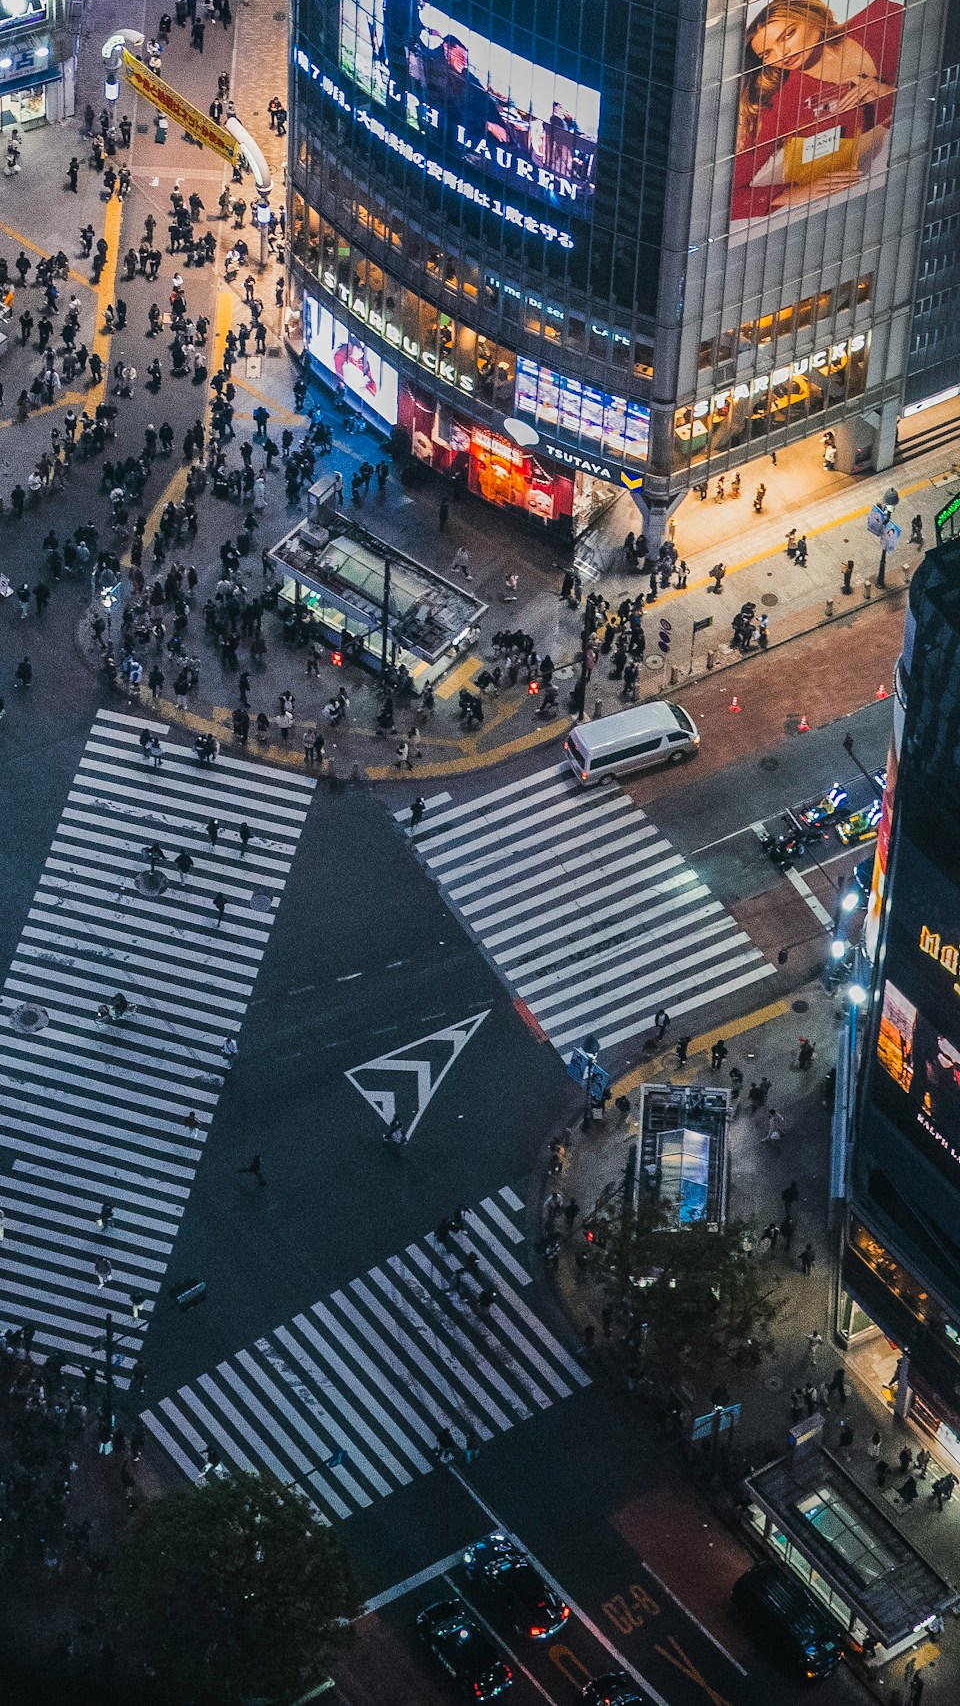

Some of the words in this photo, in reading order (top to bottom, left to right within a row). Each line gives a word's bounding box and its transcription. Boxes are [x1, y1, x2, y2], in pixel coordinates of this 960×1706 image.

[457, 125, 579, 201] LAUREN
[323, 270, 475, 392] STARBUCKS
[693, 334, 867, 418] STARBUCKS
[545, 444, 612, 480] TSUTAYA
[917, 1112, 949, 1150] RALPH
